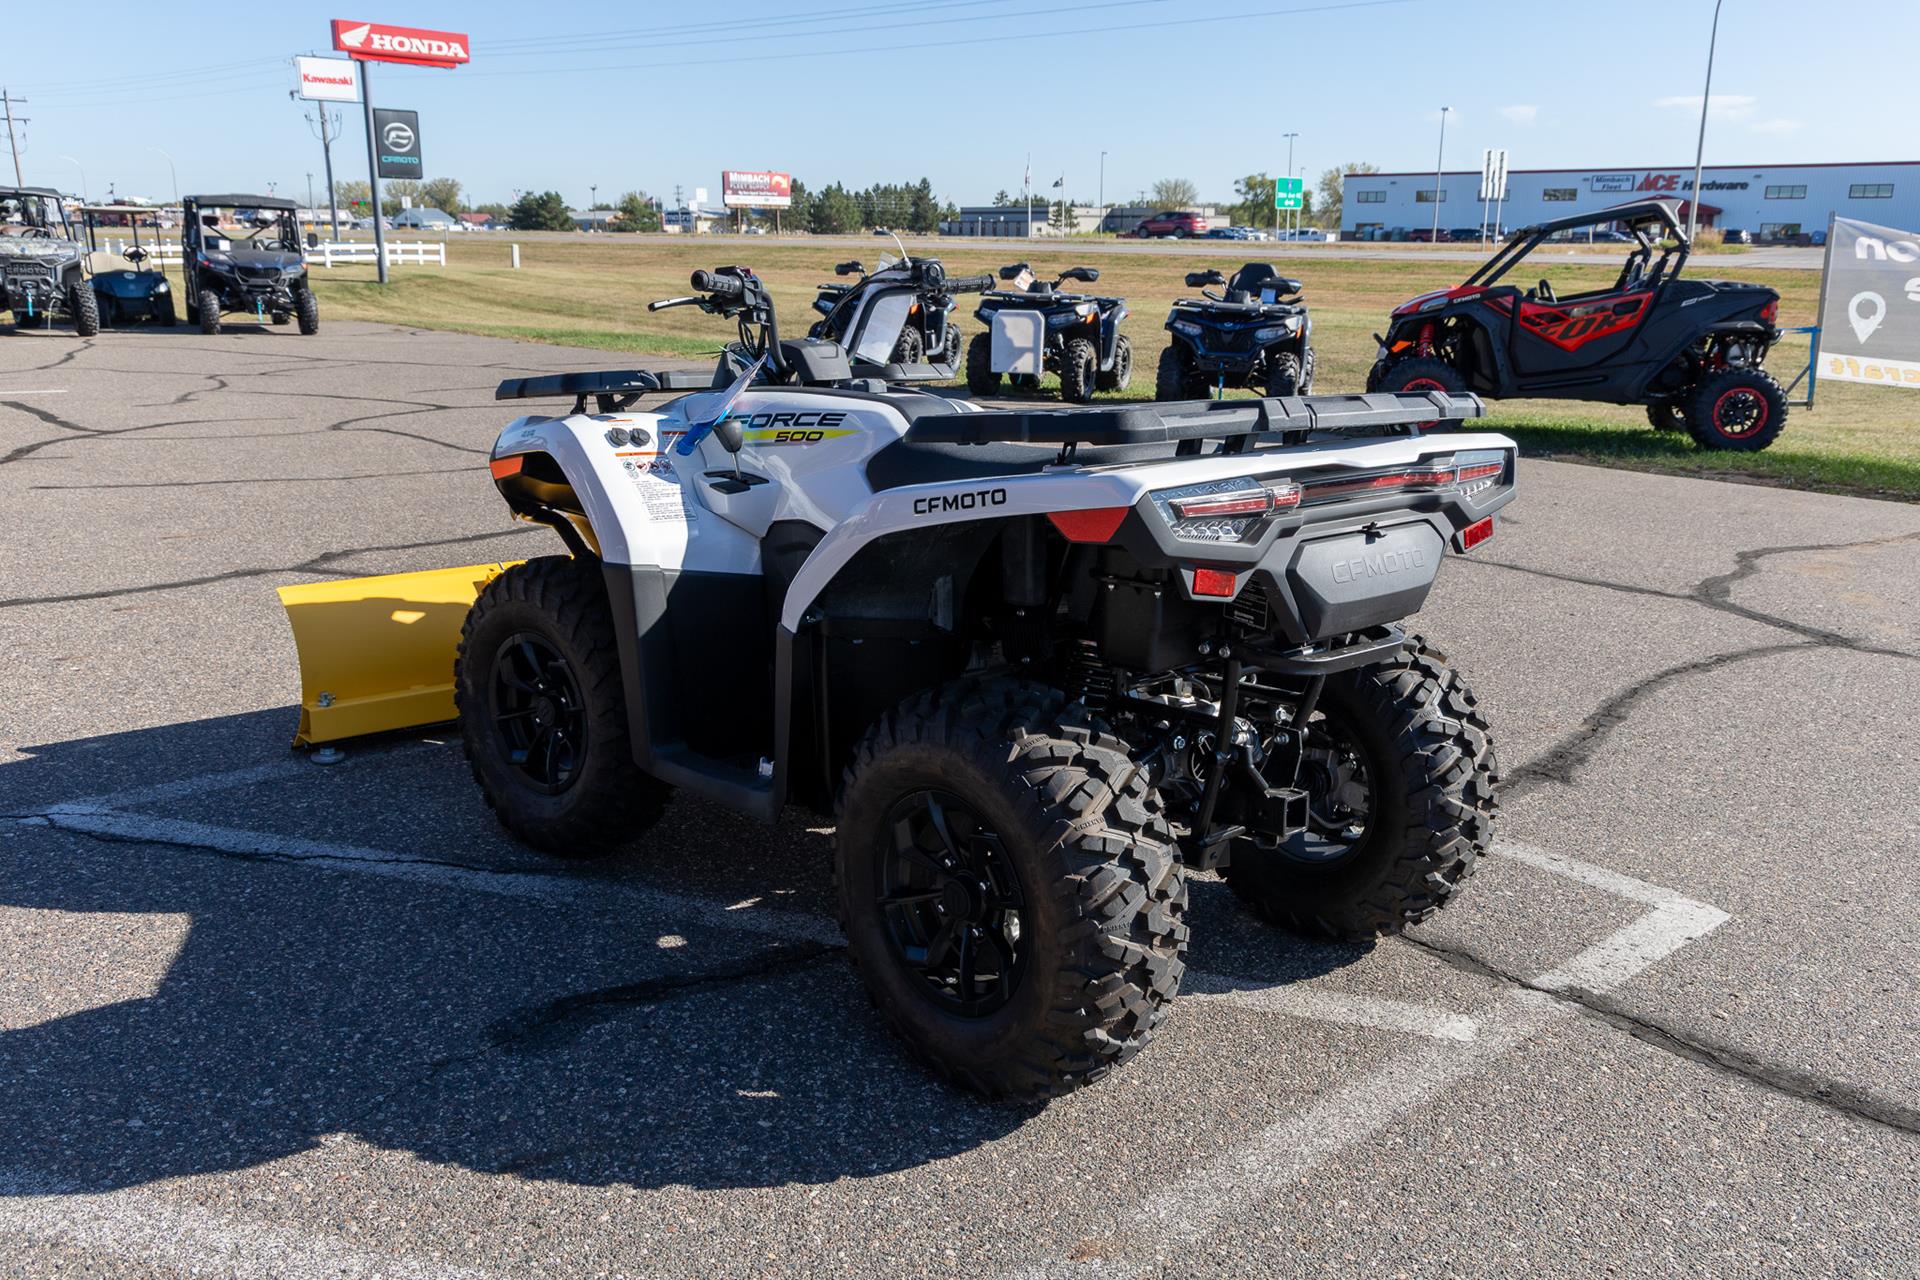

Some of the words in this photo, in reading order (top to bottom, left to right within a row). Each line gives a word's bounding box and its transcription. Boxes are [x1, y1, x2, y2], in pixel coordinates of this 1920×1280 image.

[370, 34, 468, 58] HONDA
[302, 73, 353, 86] Kawasaki
[381, 155, 419, 164] CFMOTO
[1635, 172, 1681, 192] ACE
[1682, 180, 1749, 191] Hrdware
[724, 412, 847, 428] FORCE
[774, 431, 824, 443] 500
[914, 488, 1007, 514] CFMOTO
[1331, 547, 1426, 584] CFMOTO
